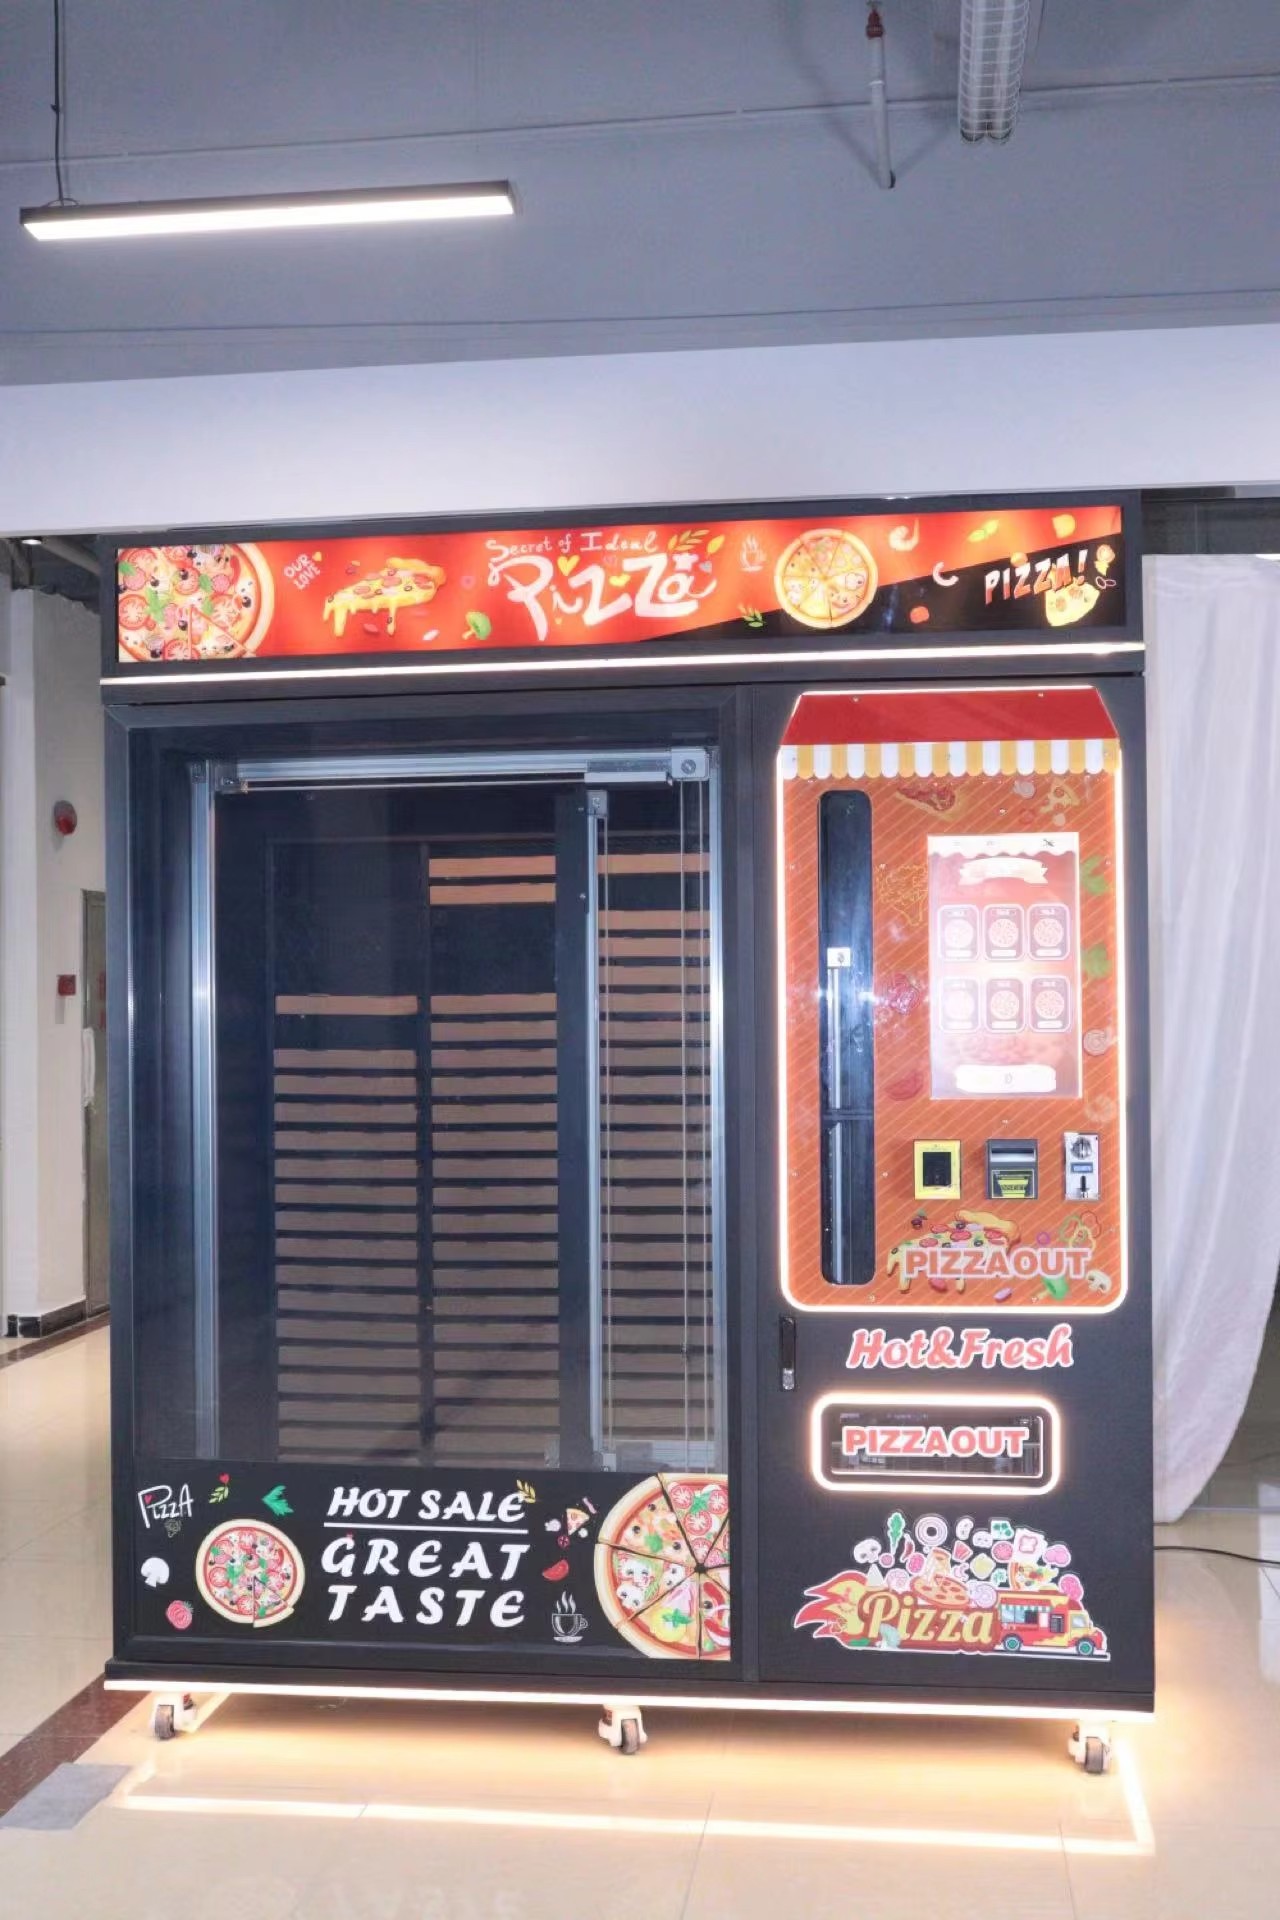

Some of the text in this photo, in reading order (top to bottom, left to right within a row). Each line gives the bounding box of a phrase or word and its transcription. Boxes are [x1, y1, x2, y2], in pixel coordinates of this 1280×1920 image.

[485, 530, 660, 562] Secret of Ideal
[904, 1248, 1092, 1279] PIZZAOUT
[846, 1323, 1075, 1370] Hot&Fresh
[842, 1426, 1030, 1458] PIZZAOUT
[327, 1486, 527, 1523] HOT SALE
[321, 1537, 530, 1581] GREAT
[327, 1584, 525, 1628] TASTE
[862, 1591, 994, 1644] Pizza
